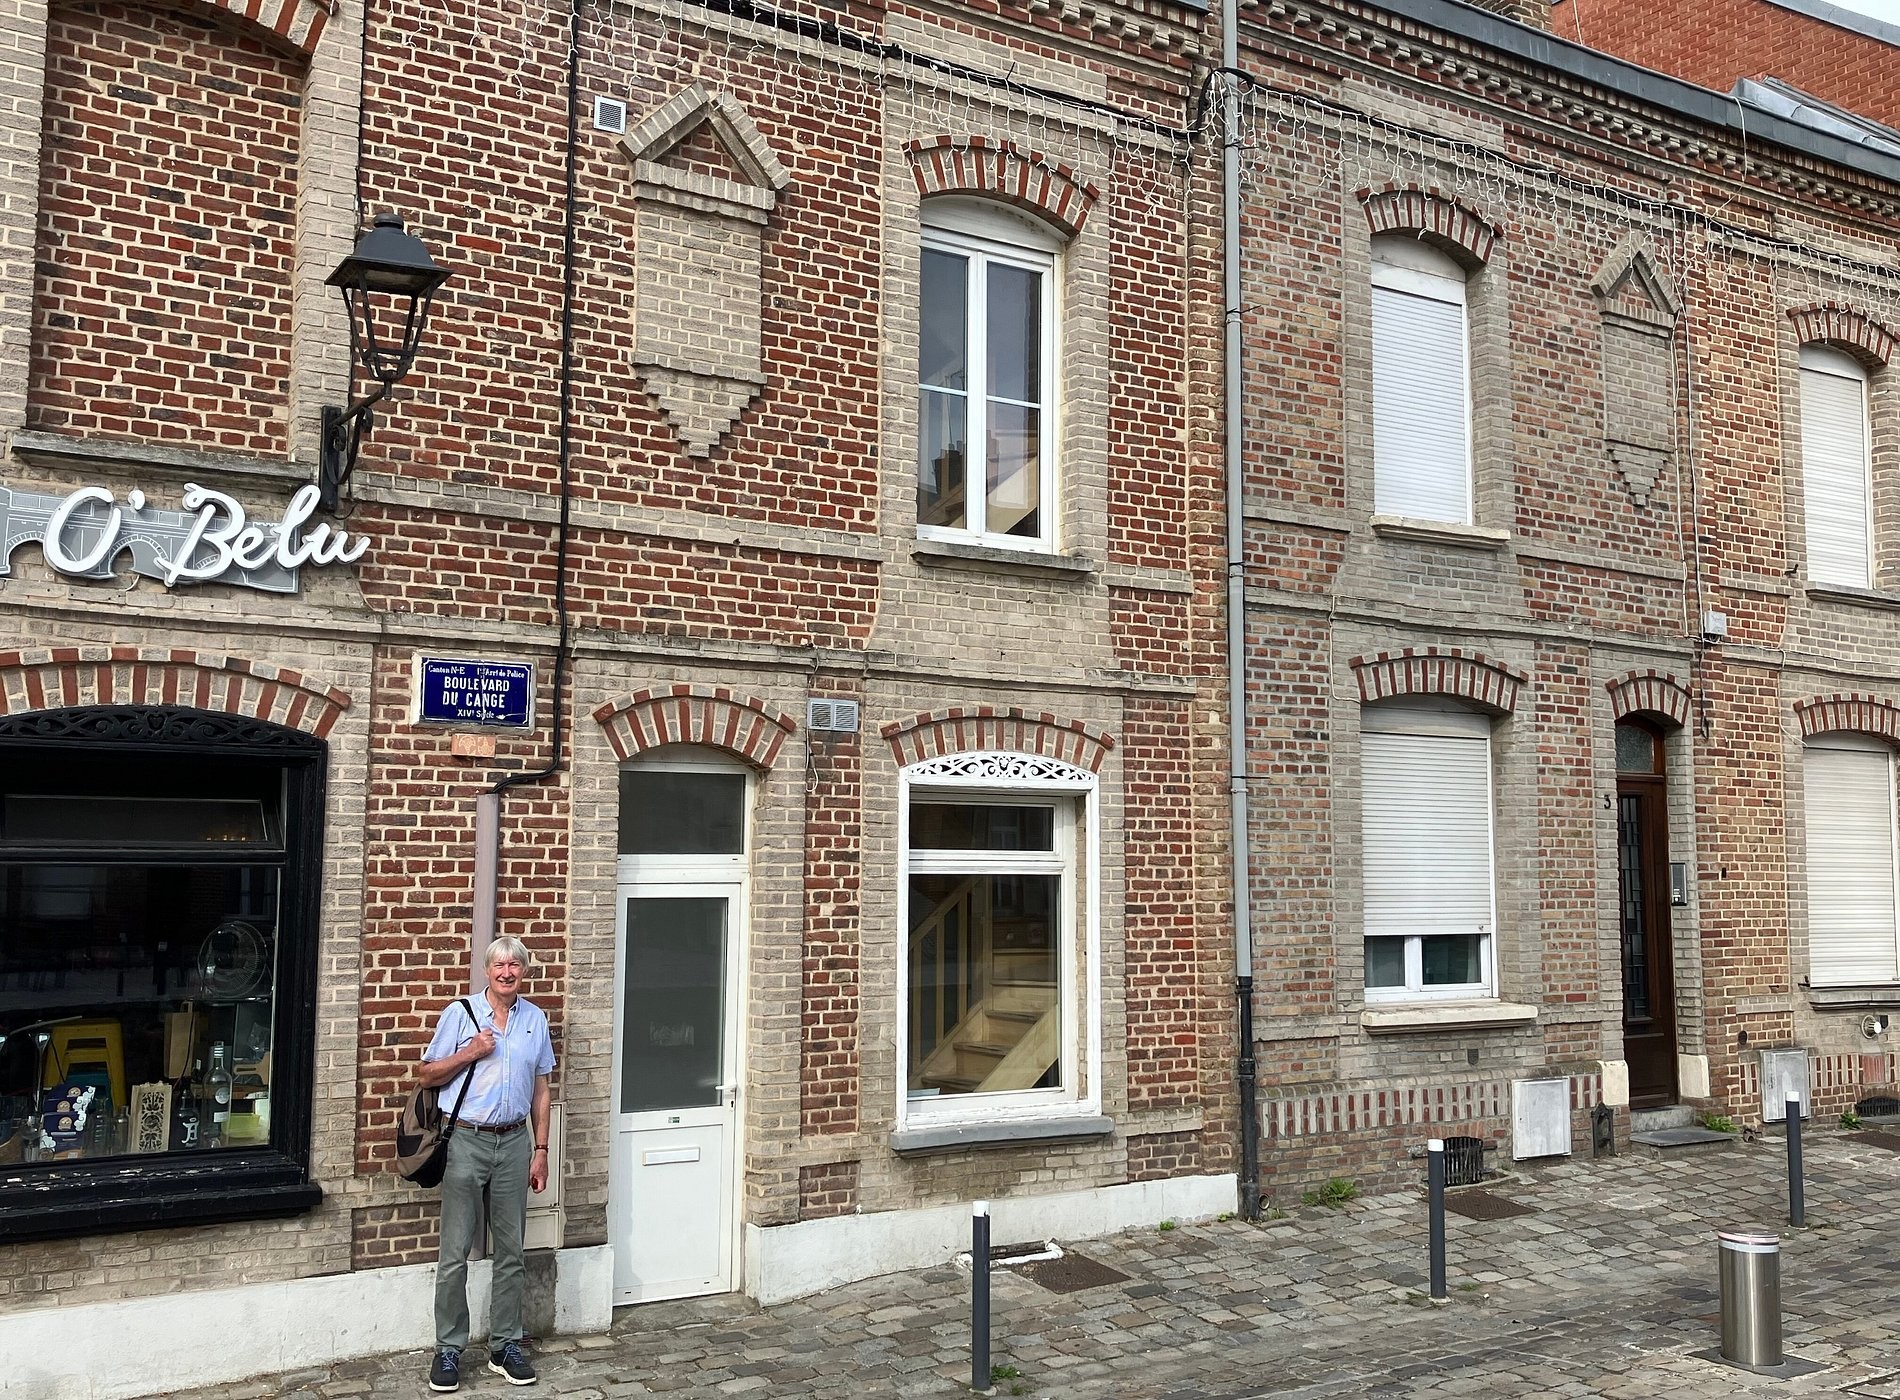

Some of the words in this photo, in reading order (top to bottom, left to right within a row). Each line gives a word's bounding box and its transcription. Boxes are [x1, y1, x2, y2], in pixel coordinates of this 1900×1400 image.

[507, 669, 525, 679] Police
[444, 676, 510, 692] BOULEVARD
[442, 691, 459, 706] DU
[465, 692, 505, 708] CANGE
[1604, 794, 1611, 809] 3
